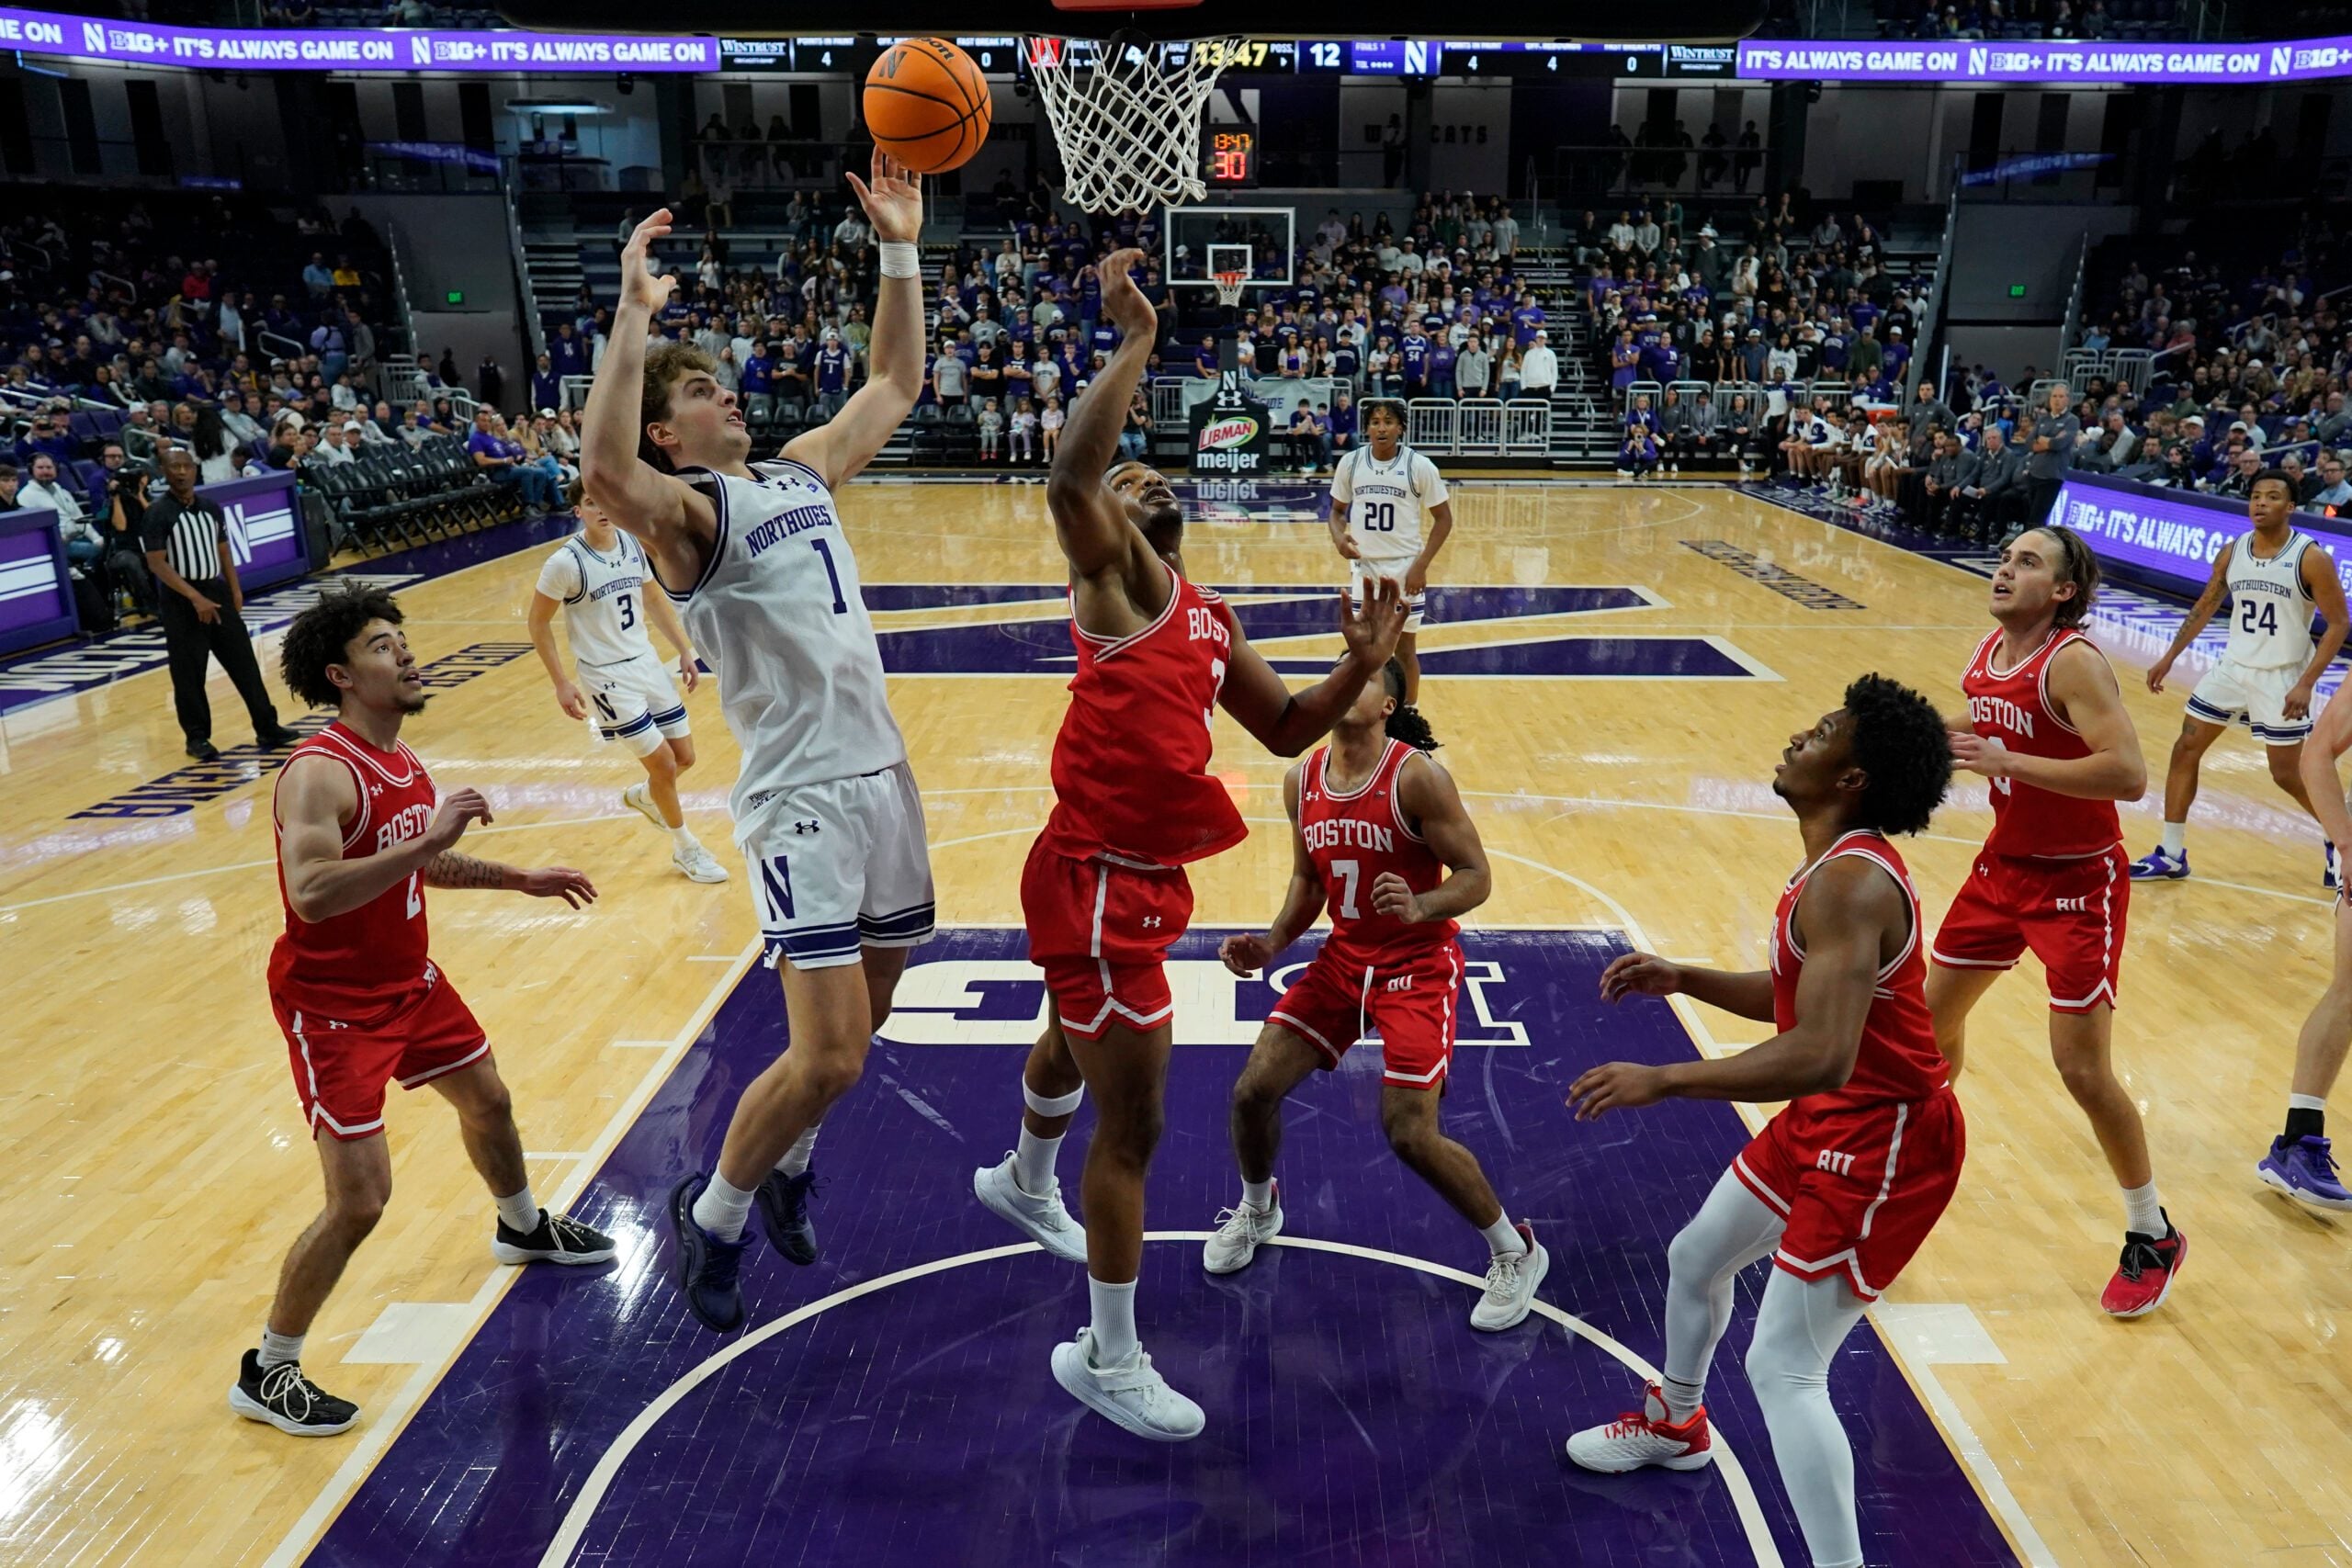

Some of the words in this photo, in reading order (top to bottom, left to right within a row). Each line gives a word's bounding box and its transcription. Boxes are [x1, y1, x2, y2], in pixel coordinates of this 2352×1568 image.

[24, 20, 62, 44] ON
[82, 22, 107, 53] N
[173, 37, 214, 59] IT'S
[217, 39, 299, 61] ALWAYS
[300, 39, 360, 61] GAME
[362, 40, 393, 61] ON
[412, 37, 431, 64] N
[492, 41, 528, 62] IT'S
[531, 41, 611, 62] ALWAYS
[613, 42, 672, 62] GAME
[674, 42, 706, 62] ON
[721, 39, 786, 53] WINTRUST
[820, 51, 831, 67] 4
[1196, 42, 1269, 67] 13:47
[1309, 42, 1341, 67] 12
[1404, 40, 1428, 74] N
[1670, 46, 1735, 60] WINTRUST
[878, 49, 909, 79] N
[981, 52, 991, 68] 0
[1467, 55, 1478, 71] 4
[1547, 55, 1557, 72] 4
[1626, 56, 1637, 73] 0
[1745, 50, 1782, 70] IT'S
[1783, 50, 1864, 71] ALWAYS
[1866, 51, 1924, 71] GAME
[1926, 51, 1957, 71] ON
[1968, 47, 1988, 75] N
[2045, 52, 2083, 72] IT'S
[2085, 52, 2165, 73] ALWAYS
[2166, 53, 2224, 73] GAME
[2226, 53, 2260, 73] ON
[2269, 47, 2291, 76] N
[1214, 132, 1250, 150] 13:47
[1214, 151, 1247, 180] 30
[1223, 370, 1238, 390] N
[1198, 422, 1253, 451] LIBMAN
[1196, 447, 1261, 473] meijer
[1353, 484, 1408, 499] NORTHWESTERN
[1364, 502, 1395, 532] 20
[223, 502, 253, 568] N
[2105, 509, 2138, 544] IT'S
[2134, 516, 2207, 561] ALWAYS
[809, 537, 848, 615] 1
[2229, 579, 2292, 600] NORTHWESTERN
[616, 593, 635, 631] 3
[2241, 599, 2278, 637] 24
[592, 692, 618, 723] N
[1303, 818, 1395, 854] BOSTON
[762, 854, 797, 923] N
[1330, 859, 1362, 919] 7
